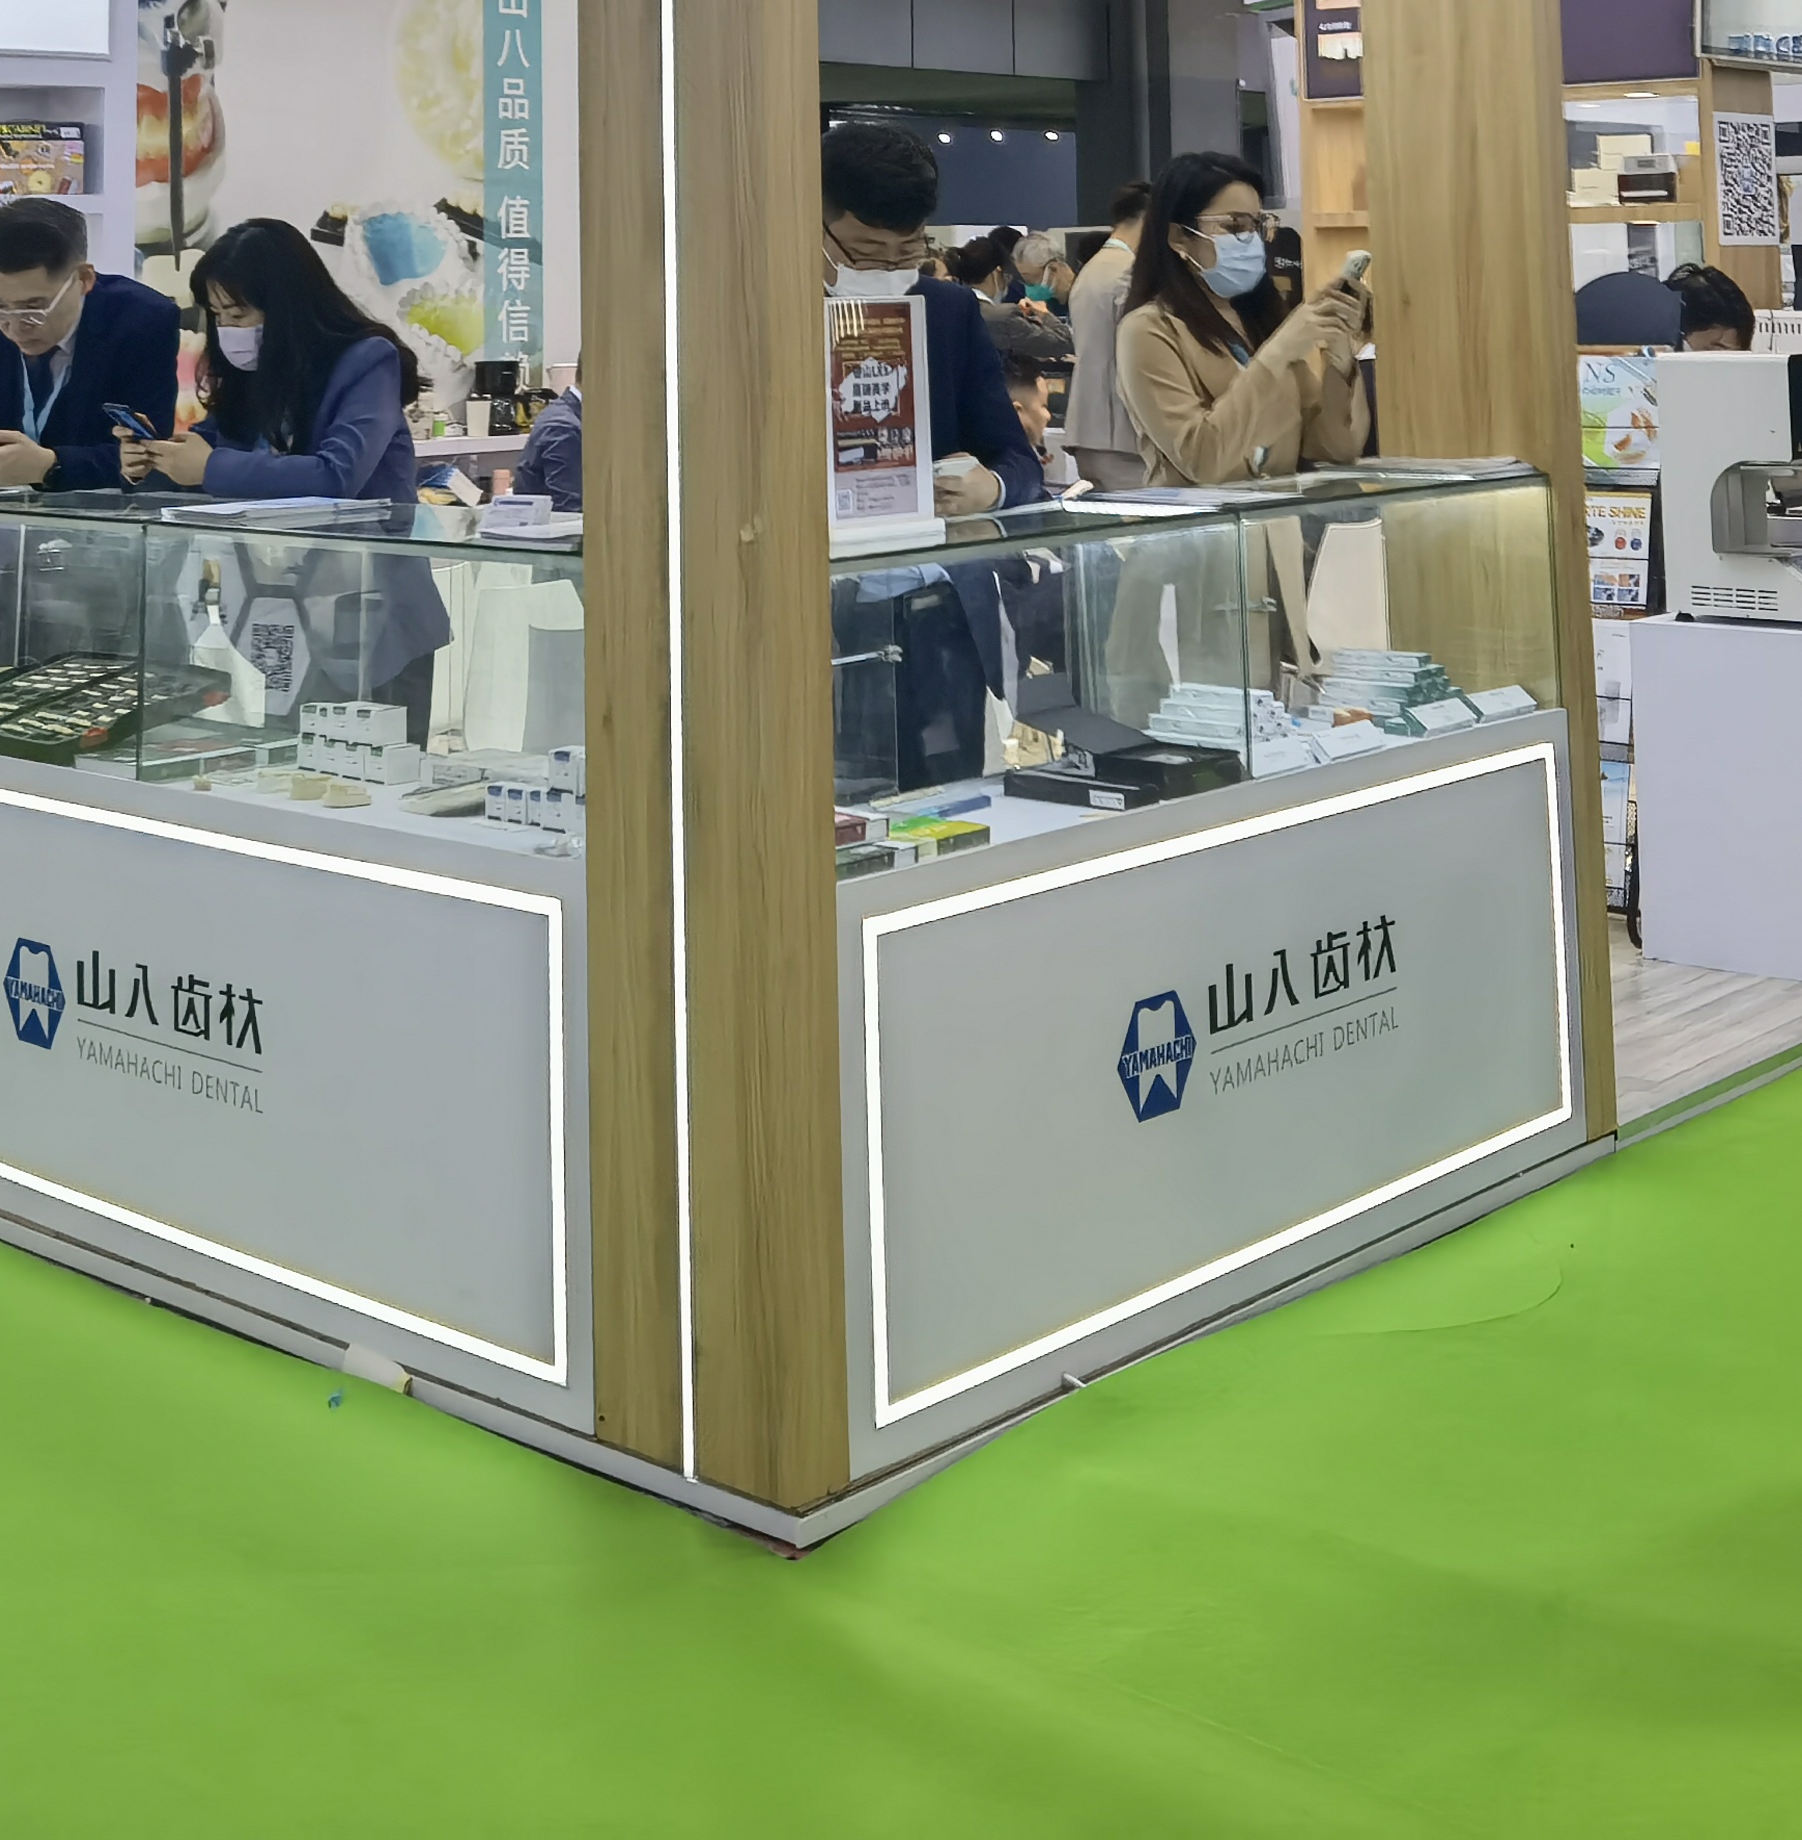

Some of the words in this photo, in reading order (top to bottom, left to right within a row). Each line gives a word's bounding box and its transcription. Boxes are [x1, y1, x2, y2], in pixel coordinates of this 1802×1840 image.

[1609, 506, 1647, 520] SHINE
[5, 975, 65, 1012] YAMAHACHI
[1121, 1034, 1193, 1079] YAMAHACHI
[1209, 1030, 1325, 1097] YAMAHACHI
[1333, 1006, 1399, 1052] DENTAL
[76, 1036, 183, 1092] YAMAHACHI
[191, 1070, 264, 1114] DENTAL
